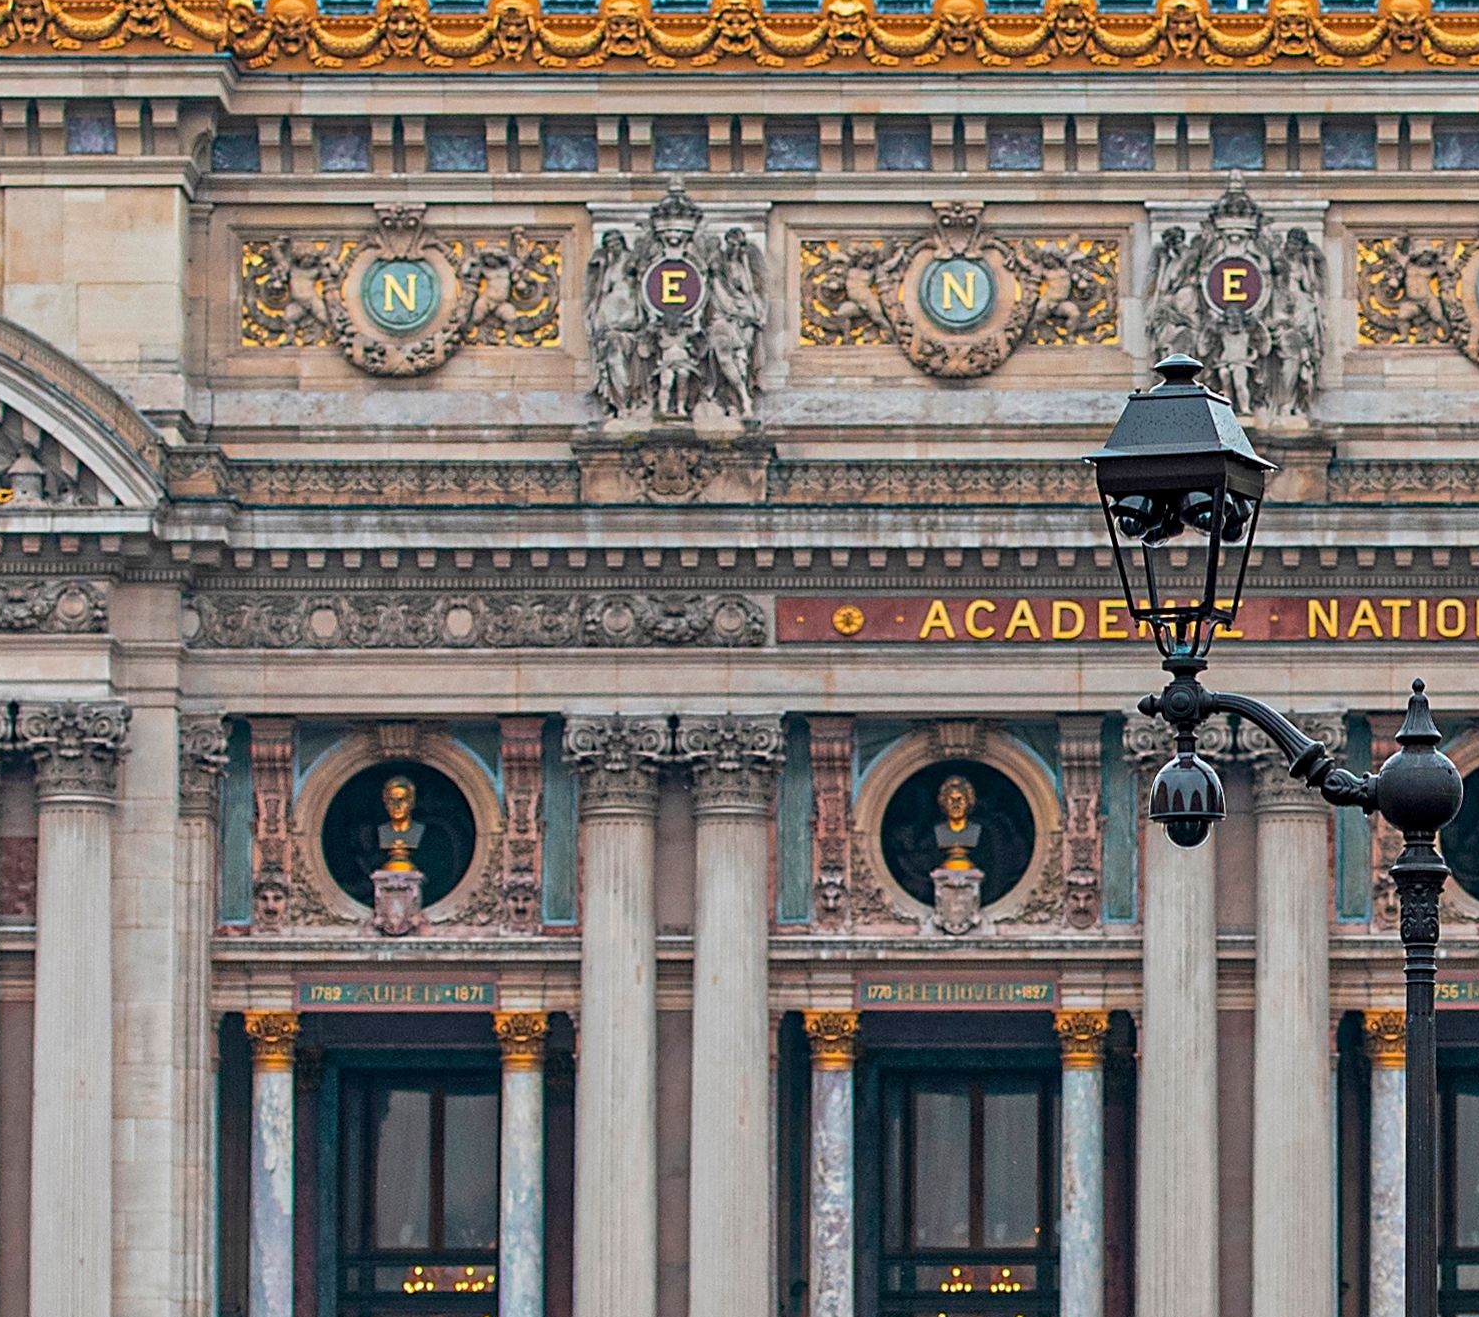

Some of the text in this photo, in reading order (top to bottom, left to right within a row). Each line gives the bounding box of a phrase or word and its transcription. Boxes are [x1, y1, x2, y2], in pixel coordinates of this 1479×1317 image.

[386, 275, 417, 311] N
[662, 270, 687, 305] E
[944, 272, 975, 309] N
[1223, 268, 1248, 302] E
[454, 986, 484, 1001] 1871
[1433, 983, 1459, 999] 756
